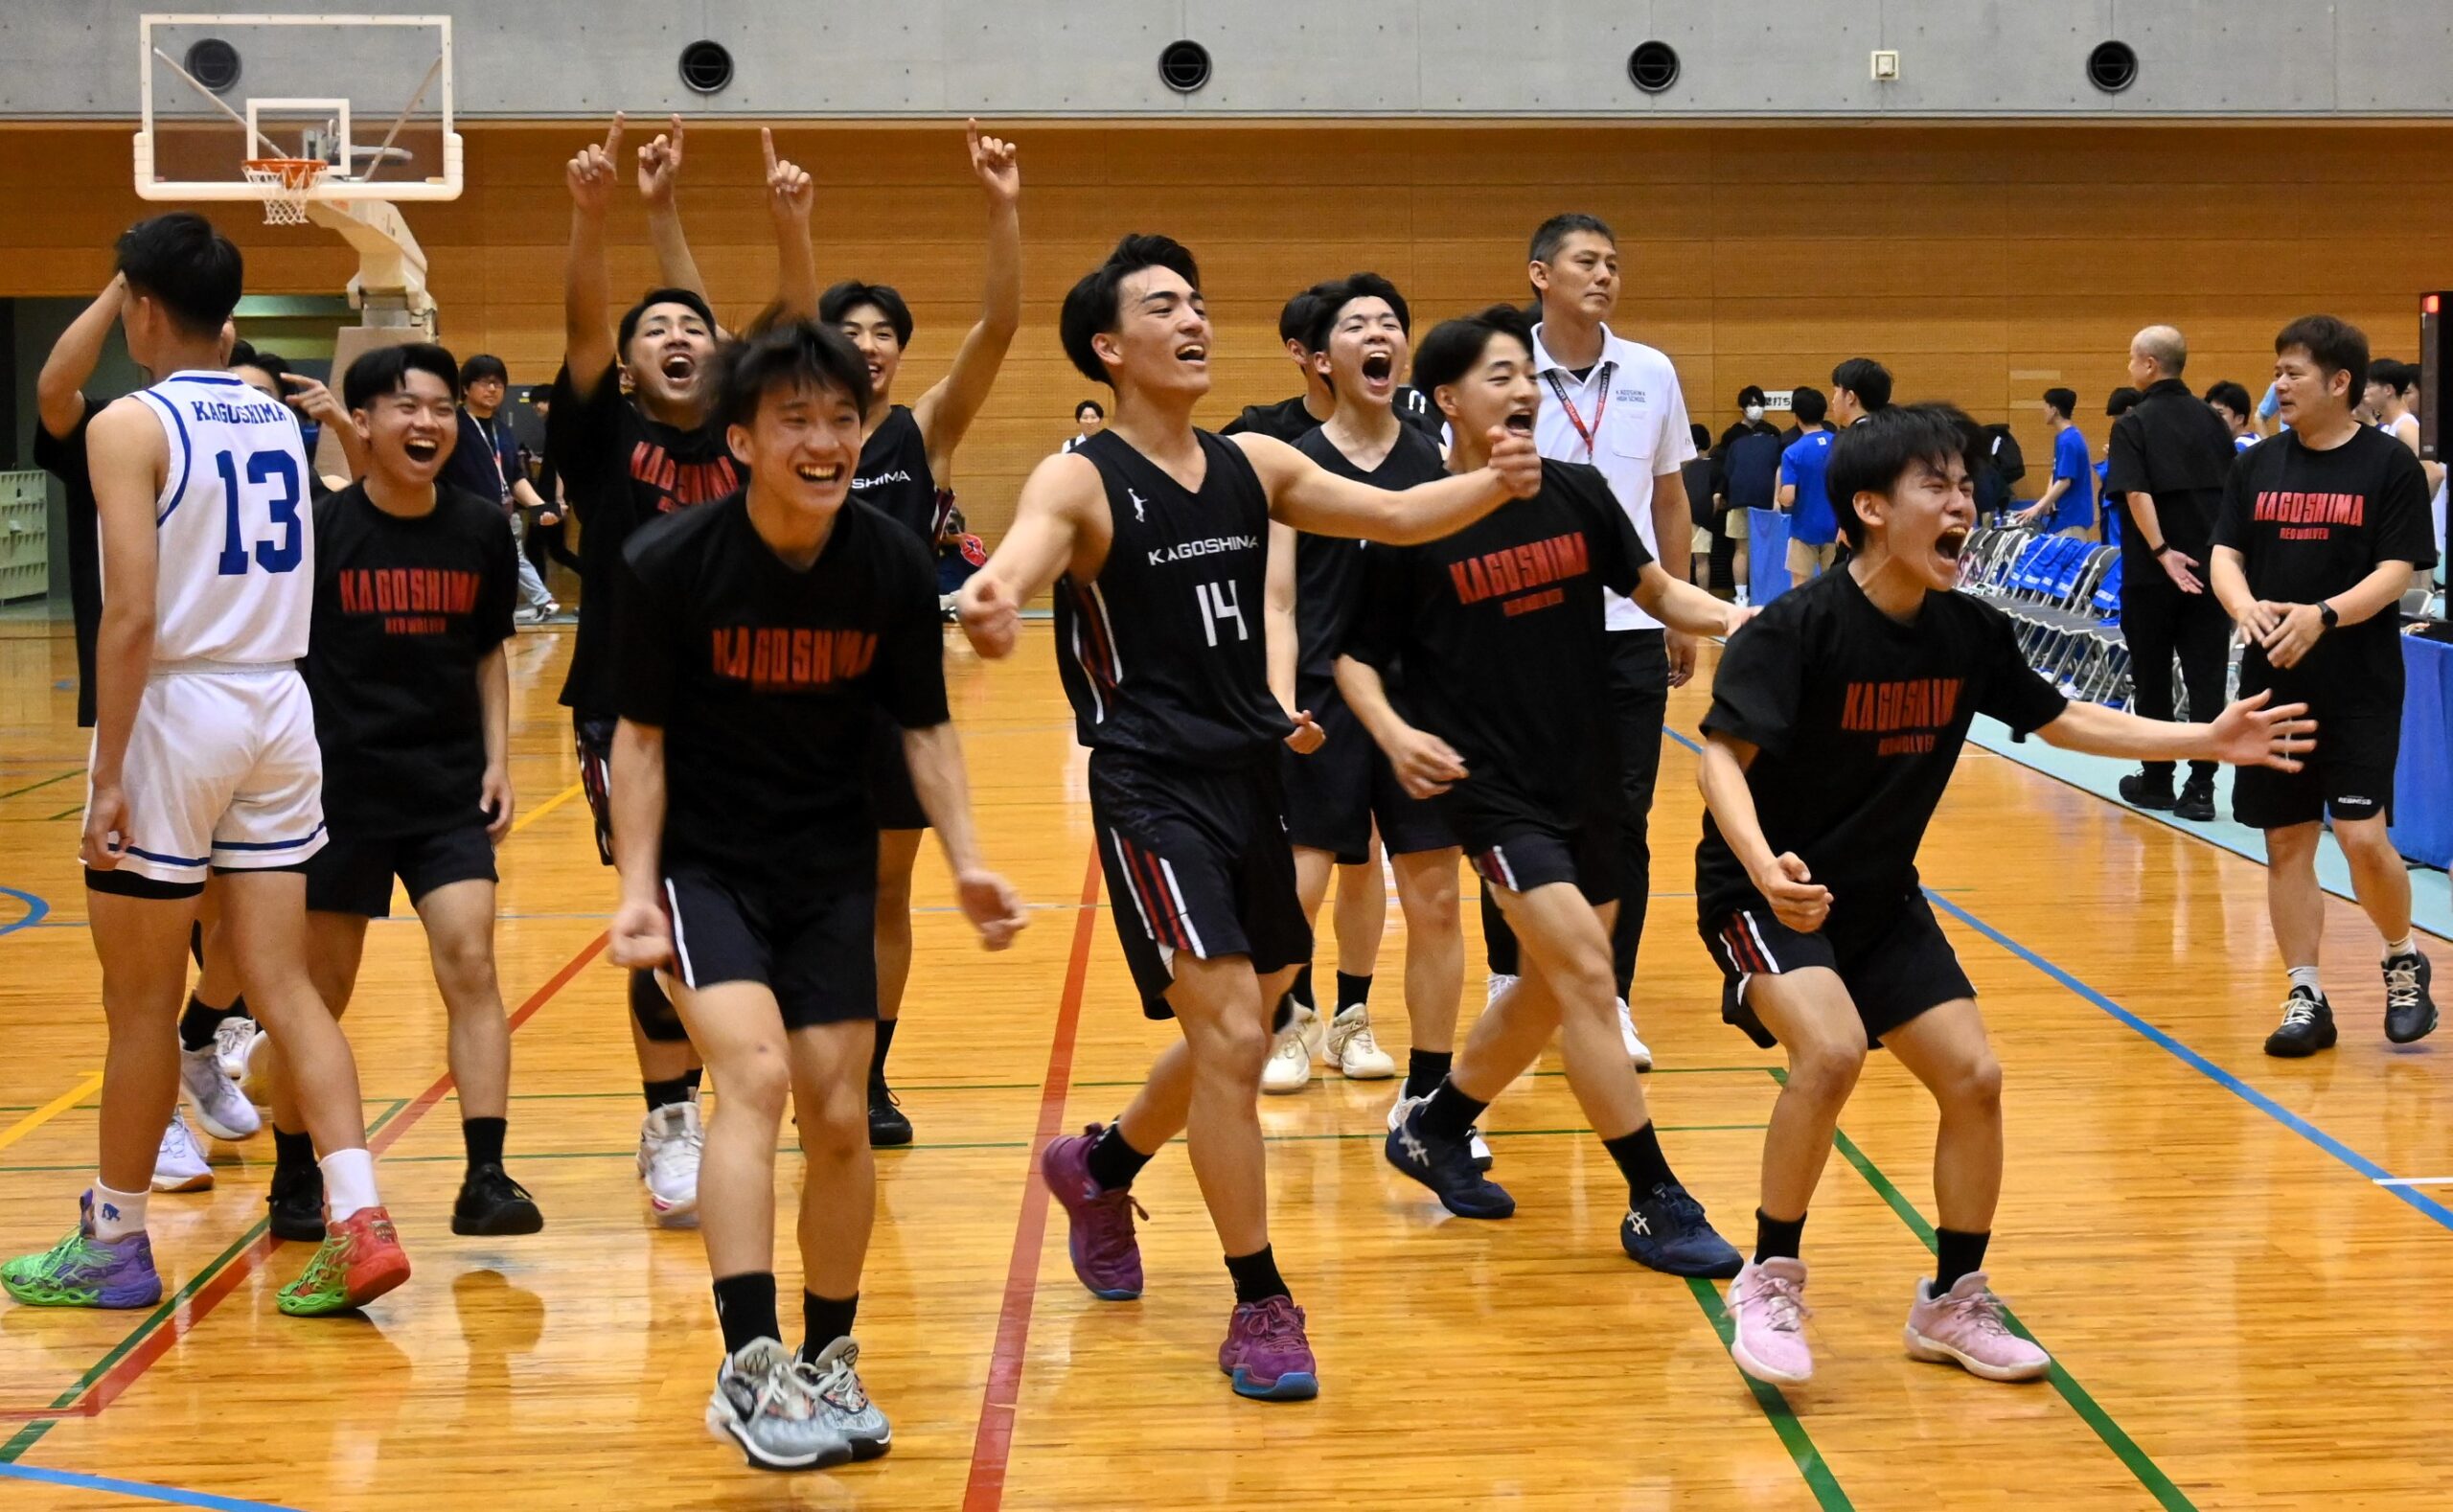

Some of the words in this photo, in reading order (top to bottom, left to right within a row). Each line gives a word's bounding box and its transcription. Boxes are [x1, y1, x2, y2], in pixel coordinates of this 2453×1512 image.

[191, 401, 287, 424] KAGOSHIMA
[216, 449, 302, 575] 13
[2254, 491, 2364, 527] KAGOSHIMA
[1148, 535, 1260, 566] KAGOSHIMA
[1195, 579, 1249, 648] 14
[1841, 677, 1964, 732] KAGOSHIM
